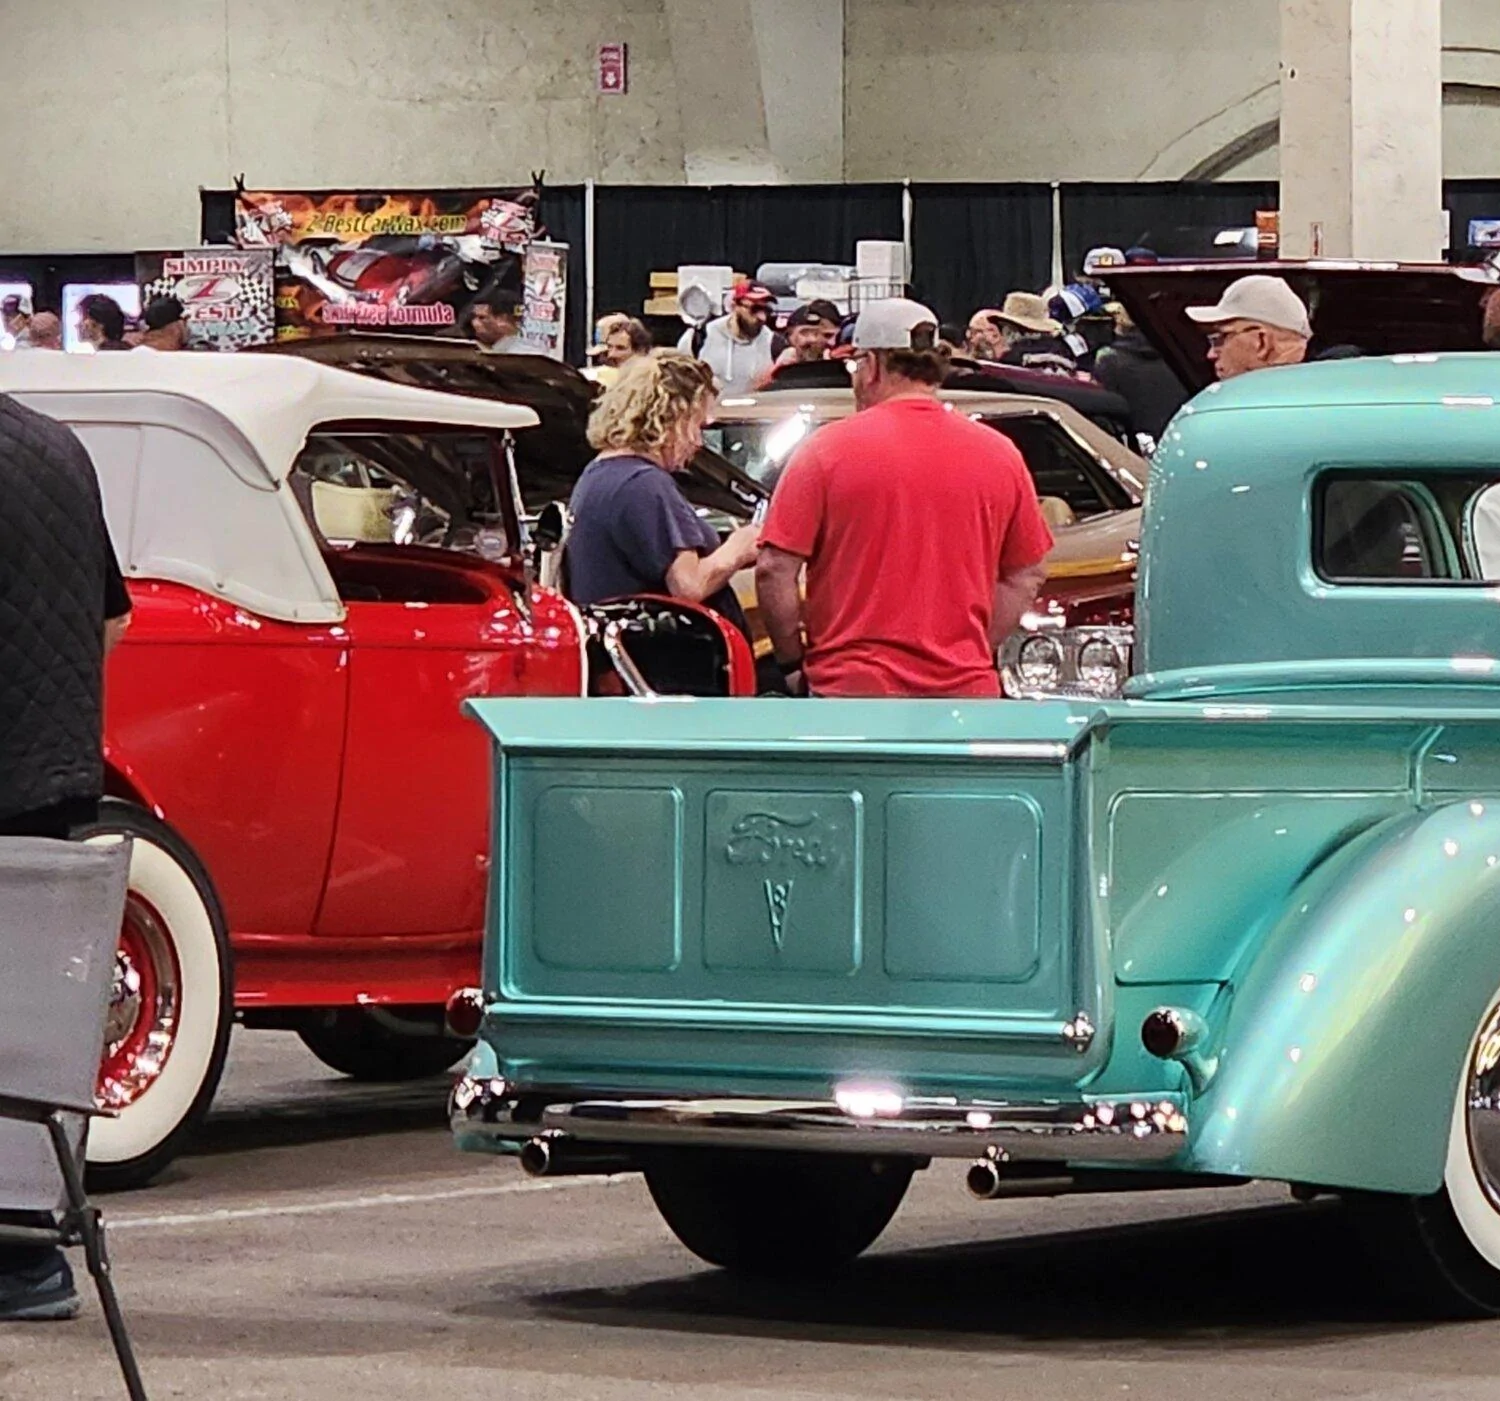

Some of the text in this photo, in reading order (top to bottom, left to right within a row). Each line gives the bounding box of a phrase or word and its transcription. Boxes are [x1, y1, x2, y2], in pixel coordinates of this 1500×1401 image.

[164, 258, 244, 275] SIMPLY
[388, 302, 455, 325] formula
[725, 811, 842, 869] Ford
